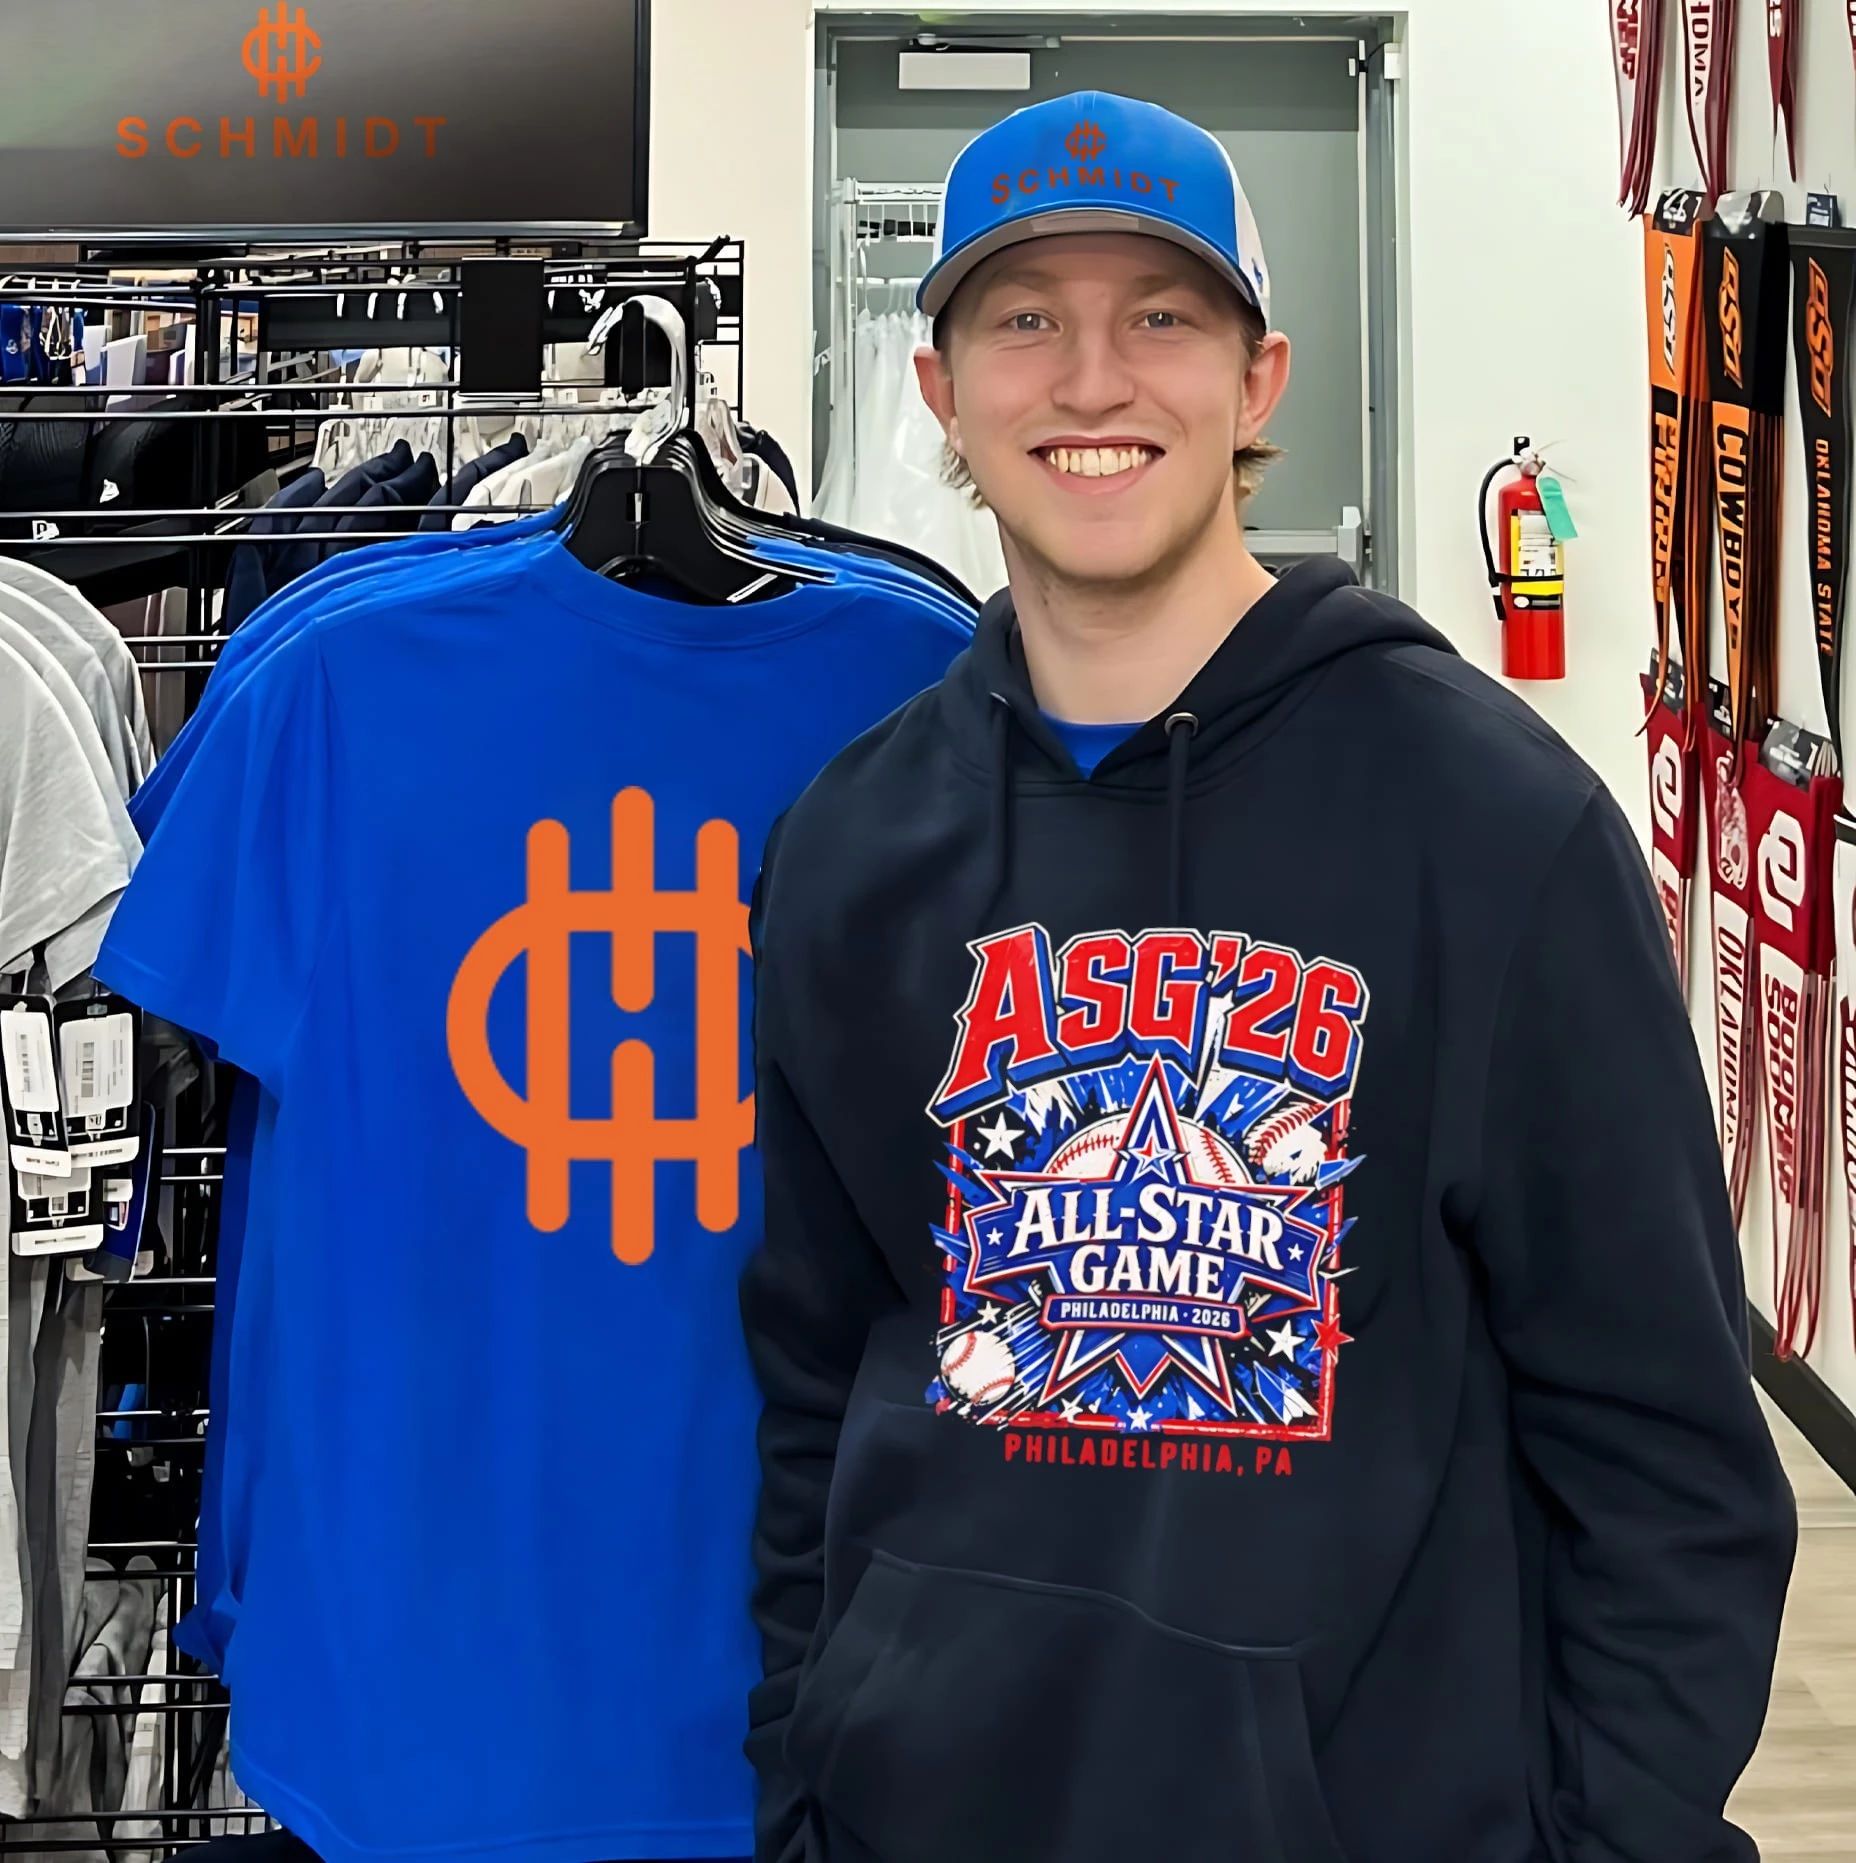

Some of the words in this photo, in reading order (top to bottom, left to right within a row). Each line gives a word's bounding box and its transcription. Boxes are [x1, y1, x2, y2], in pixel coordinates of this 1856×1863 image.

[115, 116, 448, 159] SCHMIDT
[991, 166, 1180, 205] SCHMIDT
[1815, 438, 1832, 570] OKLAHOMA
[928, 923, 1370, 1126] ASG'26
[1718, 926, 1745, 1144] OKLAHOMA
[1008, 1184, 1284, 1271] ALL-STAR
[1069, 1246, 1226, 1300] GAME
[1060, 1303, 1180, 1323] PHILADELPHIA
[1191, 1307, 1232, 1328] 2026
[1004, 1434, 1245, 1476] PHILADELPHIA,
[1256, 1448, 1293, 1476] PA
